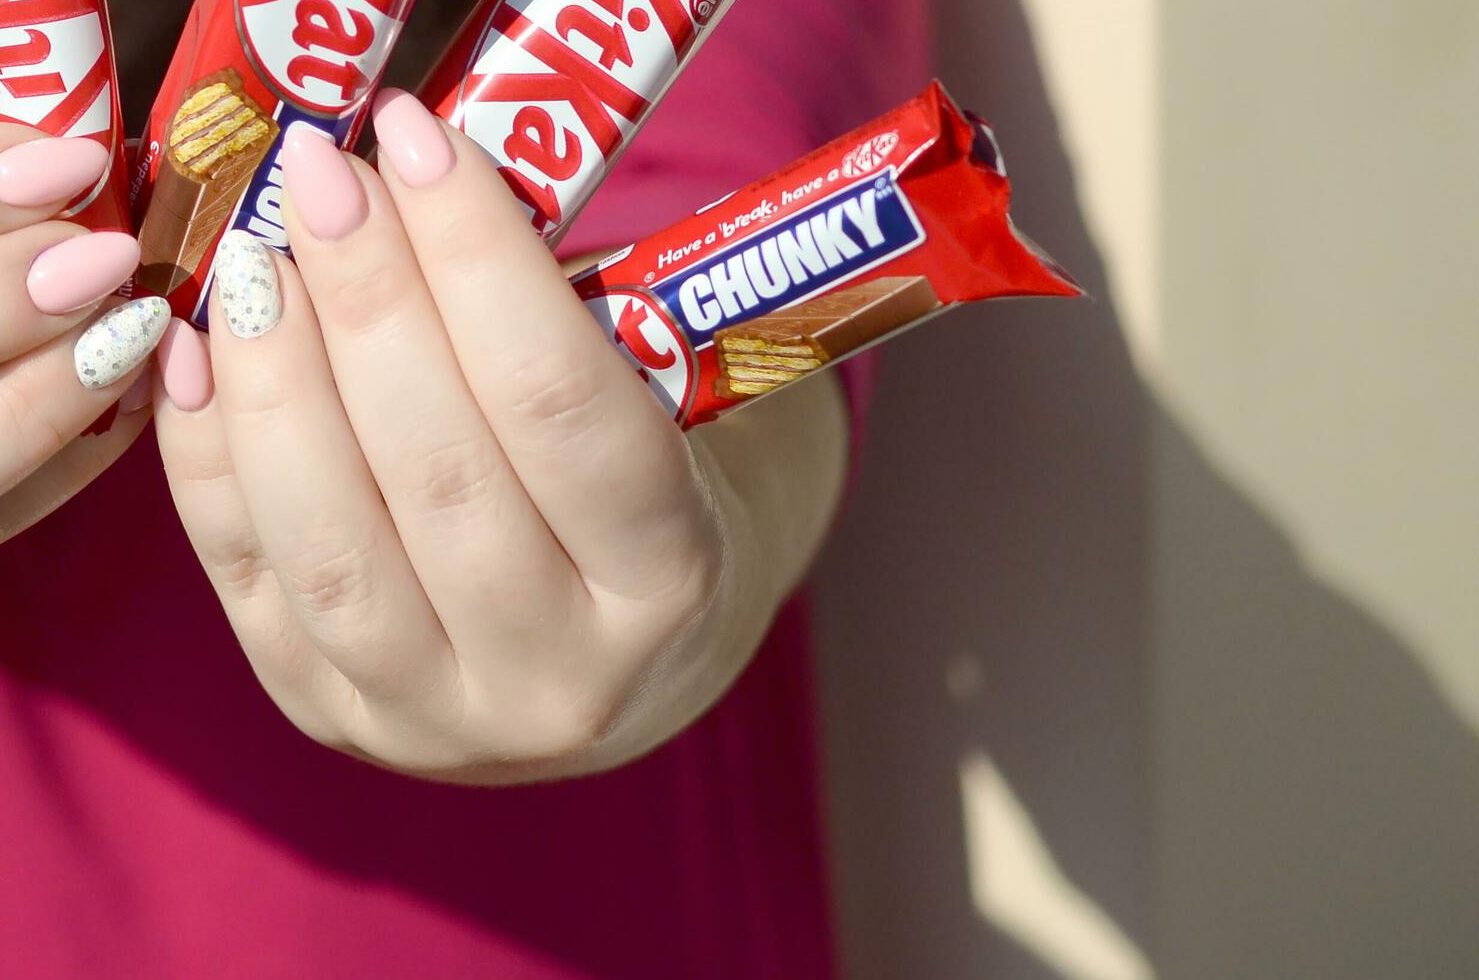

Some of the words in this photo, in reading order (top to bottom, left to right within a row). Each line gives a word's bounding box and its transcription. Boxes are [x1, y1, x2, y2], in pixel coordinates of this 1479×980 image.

[658, 238, 702, 269] Have
[704, 231, 716, 245] a
[781, 177, 823, 205] have
[827, 168, 839, 182] a
[679, 188, 886, 331] CHUNKY
